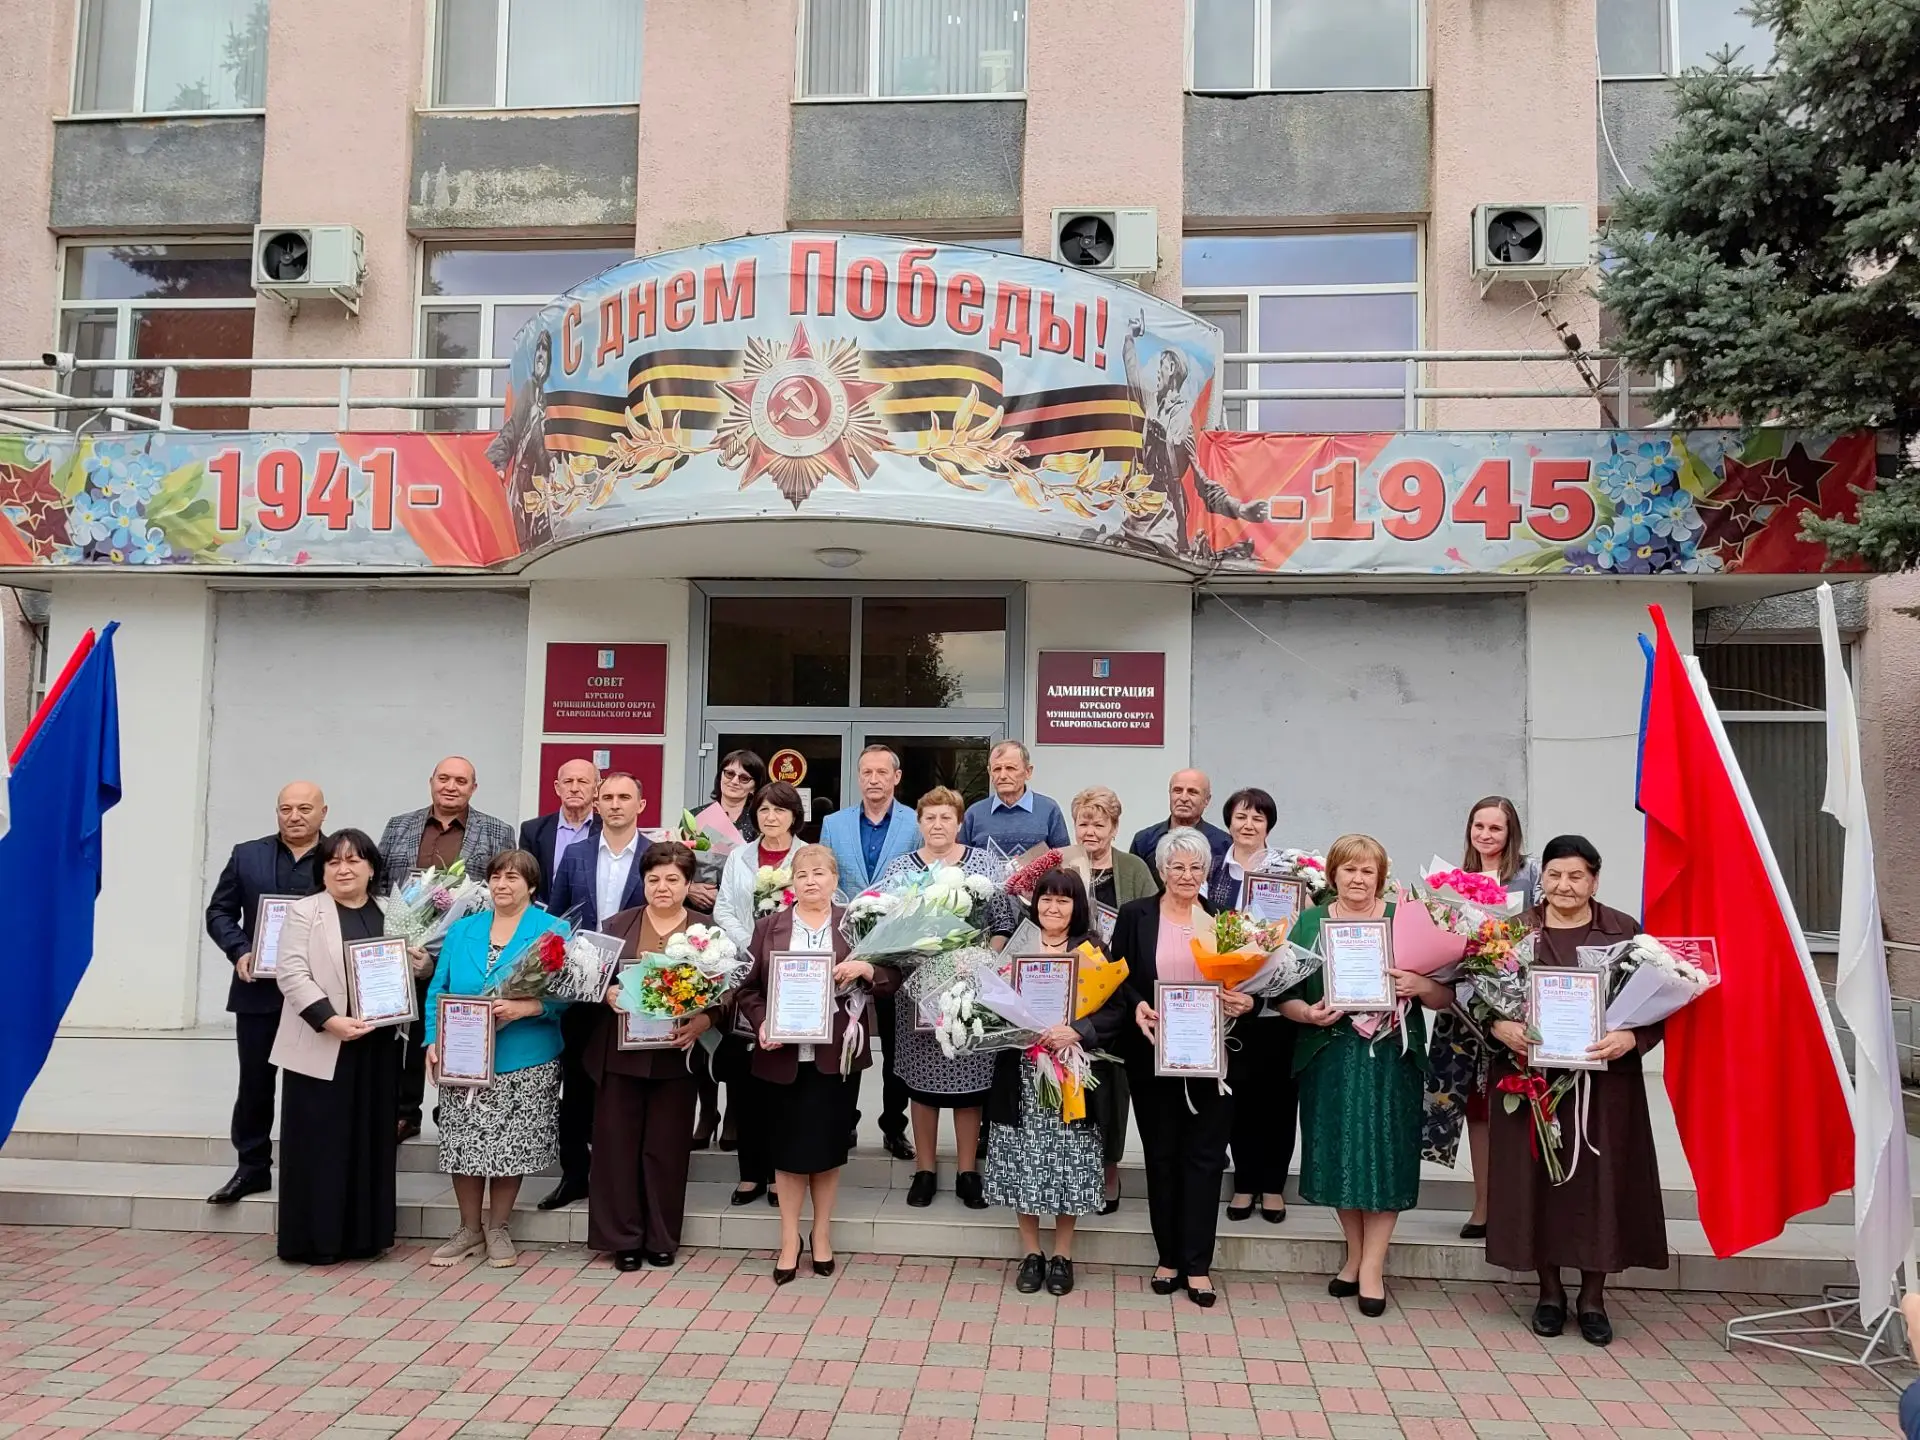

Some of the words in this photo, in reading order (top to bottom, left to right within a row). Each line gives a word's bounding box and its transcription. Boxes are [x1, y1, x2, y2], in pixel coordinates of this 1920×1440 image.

[562, 302, 583, 377] С
[788, 238, 1109, 371] Победы!
[208, 449, 441, 532] 1941-
[1270, 458, 1596, 541] -1945
[587, 676, 625, 687] СОВЕТ
[584, 692, 625, 700] КУРСКОГО
[1046, 685, 1155, 698] АДМИНИСТРАЦИЯ
[552, 700, 626, 709] МУНИЦИПАЛЬНОГО
[627, 701, 656, 709] ОКРУГА
[1079, 701, 1121, 710] КУРСКОГО
[556, 710, 631, 718] СТАВРОПОЛЬСКОГО
[632, 710, 652, 718] КРАЯ
[1046, 710, 1123, 720] МУНИЦИПАЛЬНОГО
[1124, 711, 1155, 719] ОКРУГА
[1050, 720, 1129, 729] СТАВРОПОЛЬСКОГО
[1129, 721, 1151, 729] КРАЯ
